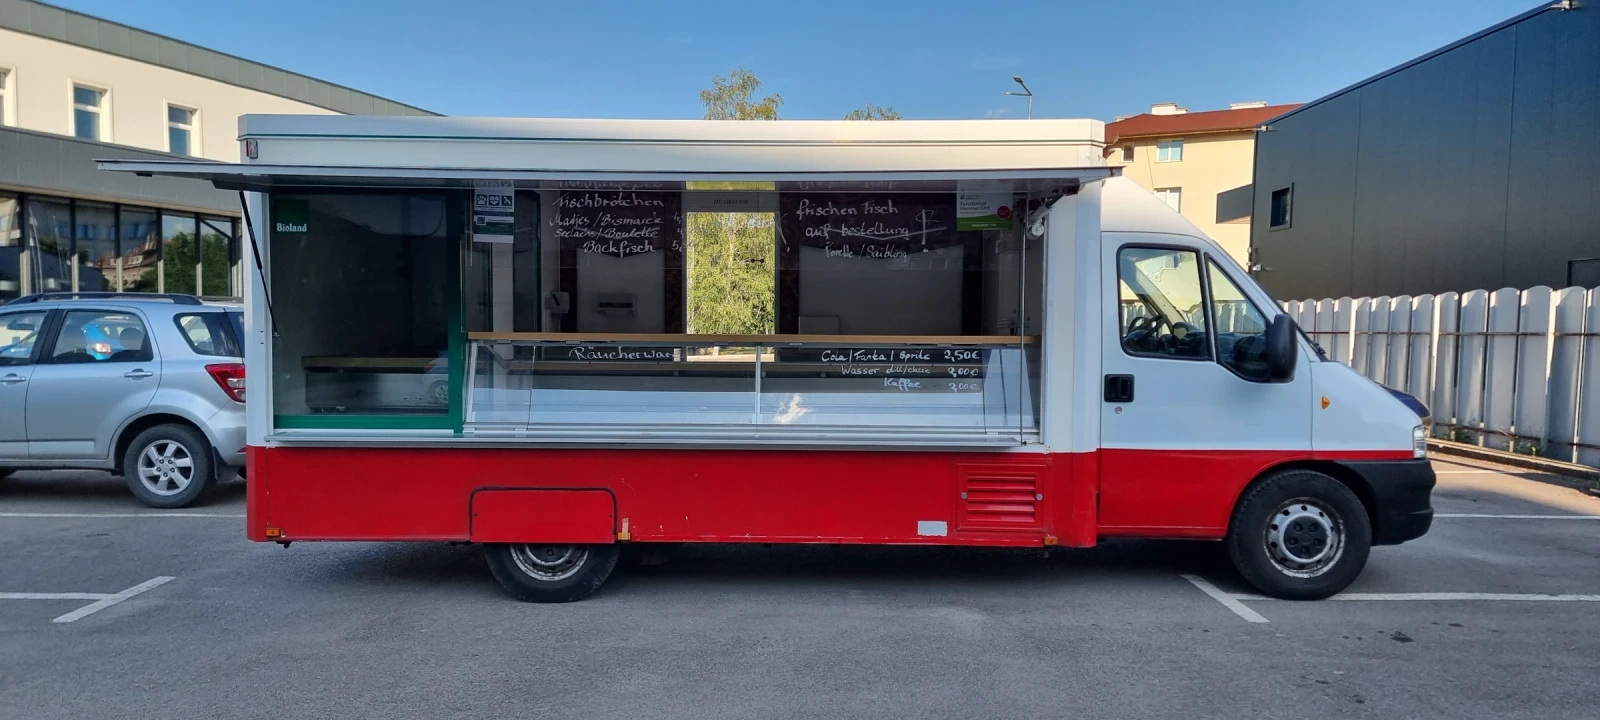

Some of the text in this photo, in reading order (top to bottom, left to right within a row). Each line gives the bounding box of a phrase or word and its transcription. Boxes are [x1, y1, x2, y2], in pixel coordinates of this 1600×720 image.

[796, 199, 858, 220] frischen
[276, 222, 307, 232] Bioland
[582, 240, 656, 259] Backfisch
[900, 349, 931, 363] Sprite
[943, 349, 980, 362] 2,50€
[841, 364, 880, 375] Wasser
[884, 377, 921, 392] Kaffee
